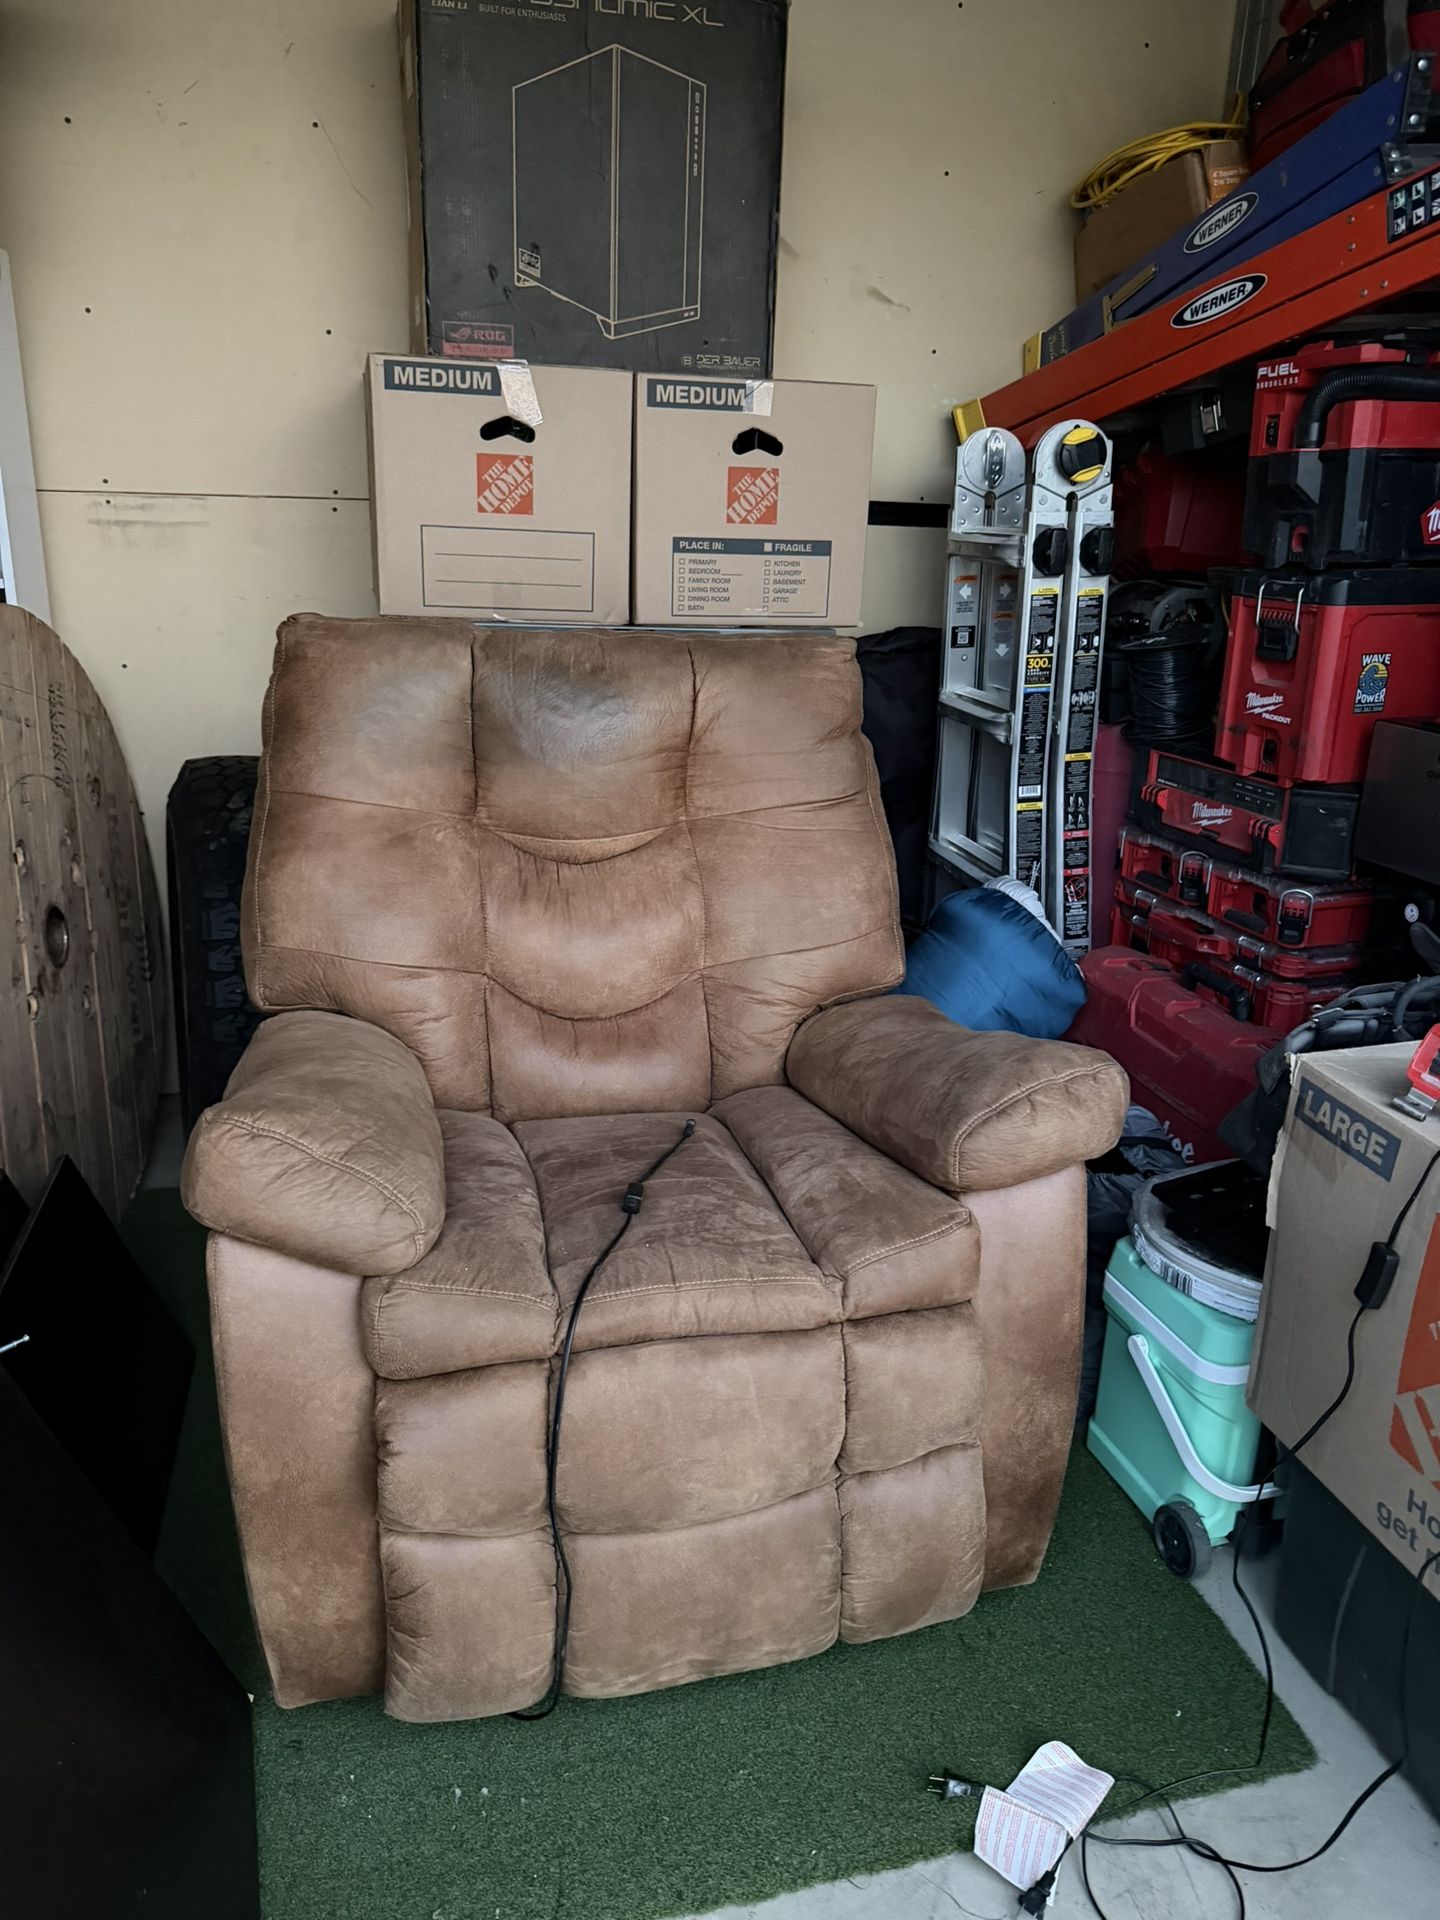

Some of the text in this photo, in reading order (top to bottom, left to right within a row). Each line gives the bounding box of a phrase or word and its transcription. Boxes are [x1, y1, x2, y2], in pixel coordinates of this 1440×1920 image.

[479, 3, 567, 22] BUILT FOR ENTHUSIASTS
[682, 4, 724, 27] XL
[1198, 203, 1243, 243] WERNER
[1190, 283, 1247, 319] WERNER
[474, 329, 506, 341] ROG
[393, 366, 493, 390] MEDIUM
[1257, 362, 1300, 380] FUEL
[656, 384, 746, 406] MEDIUM
[481, 460, 507, 484] THE
[478, 455, 534, 514] HOME
[732, 473, 755, 497] THE
[500, 477, 534, 515] DEPOT
[727, 467, 780, 525] HOME
[746, 489, 779, 525] DEPOT
[679, 541, 725, 550] PLACE IN:
[775, 543, 813, 553] FRAGILE
[688, 558, 718, 566] PRIMARY
[688, 567, 721, 575] BEDROOM
[772, 578, 807, 586] BASEMENT
[773, 569, 803, 577] LAUNDRY
[772, 587, 799, 595] GARAGE
[772, 596, 790, 604] ATTIC
[1027, 658, 1049, 669] 300
[1362, 653, 1392, 667] WAVE
[1245, 692, 1284, 709] Milwaukee
[1355, 687, 1387, 704] POWER
[1261, 713, 1293, 724] PACKOUT
[1191, 801, 1233, 819] Milwaukee
[1303, 1089, 1388, 1166] LARGE
[1376, 1501, 1419, 1553] get
